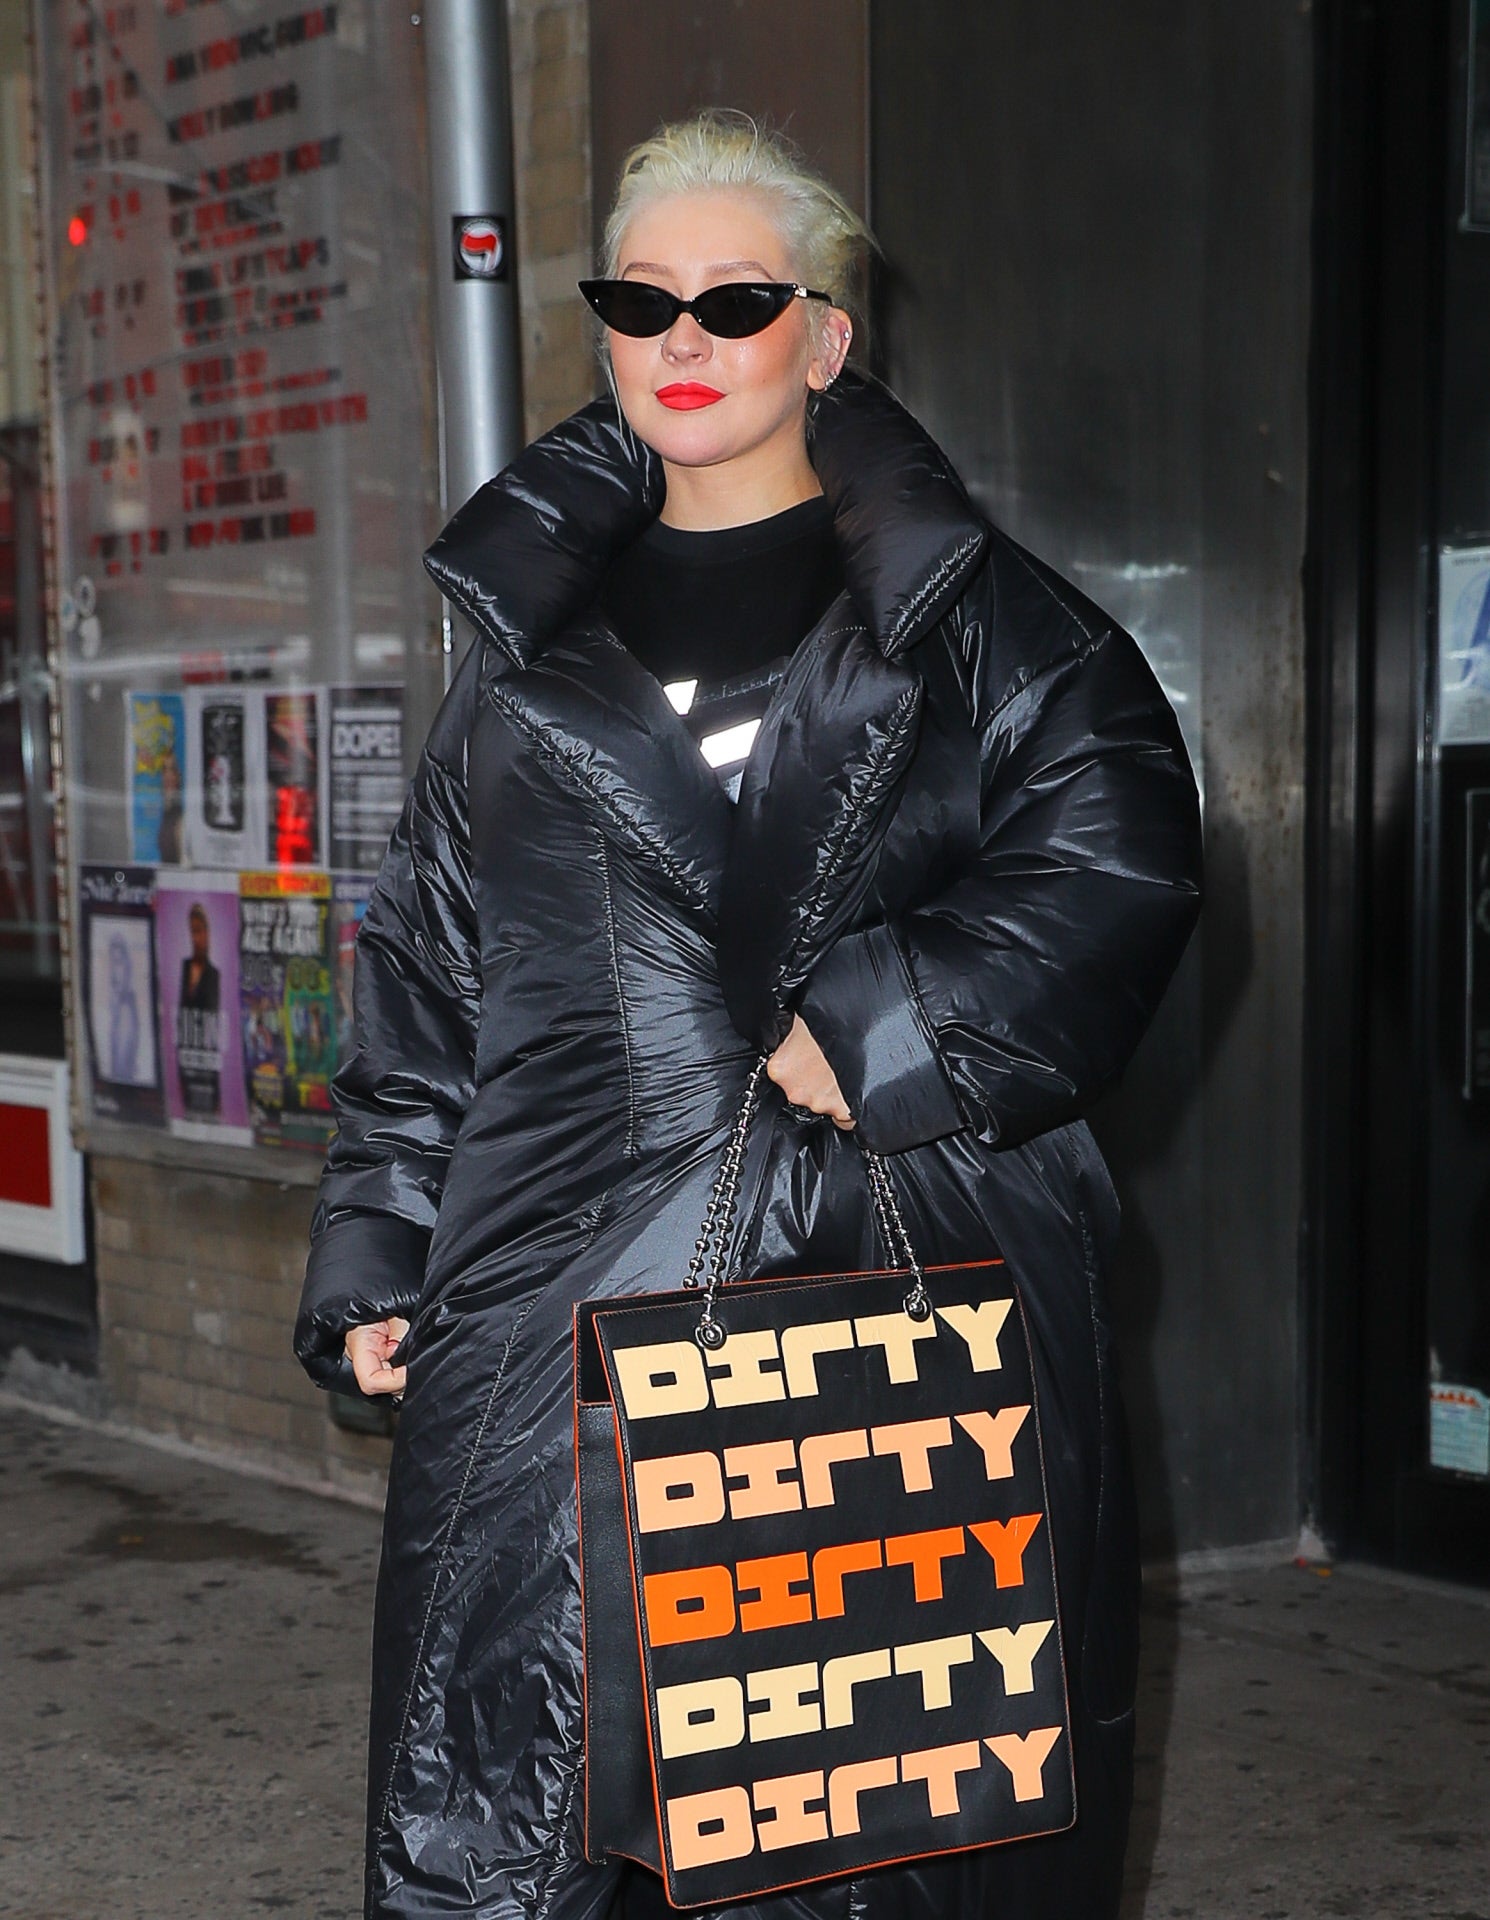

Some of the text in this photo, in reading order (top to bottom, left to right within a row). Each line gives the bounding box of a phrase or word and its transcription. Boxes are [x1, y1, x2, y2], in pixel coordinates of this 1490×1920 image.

[613, 1299, 1013, 1420] DIRTY
[634, 1405, 1030, 1534] DIRTY
[644, 1513, 1043, 1648] DIRTY
[657, 1620, 1055, 1760] DIRTY
[667, 1727, 1062, 1871] DIRTY
